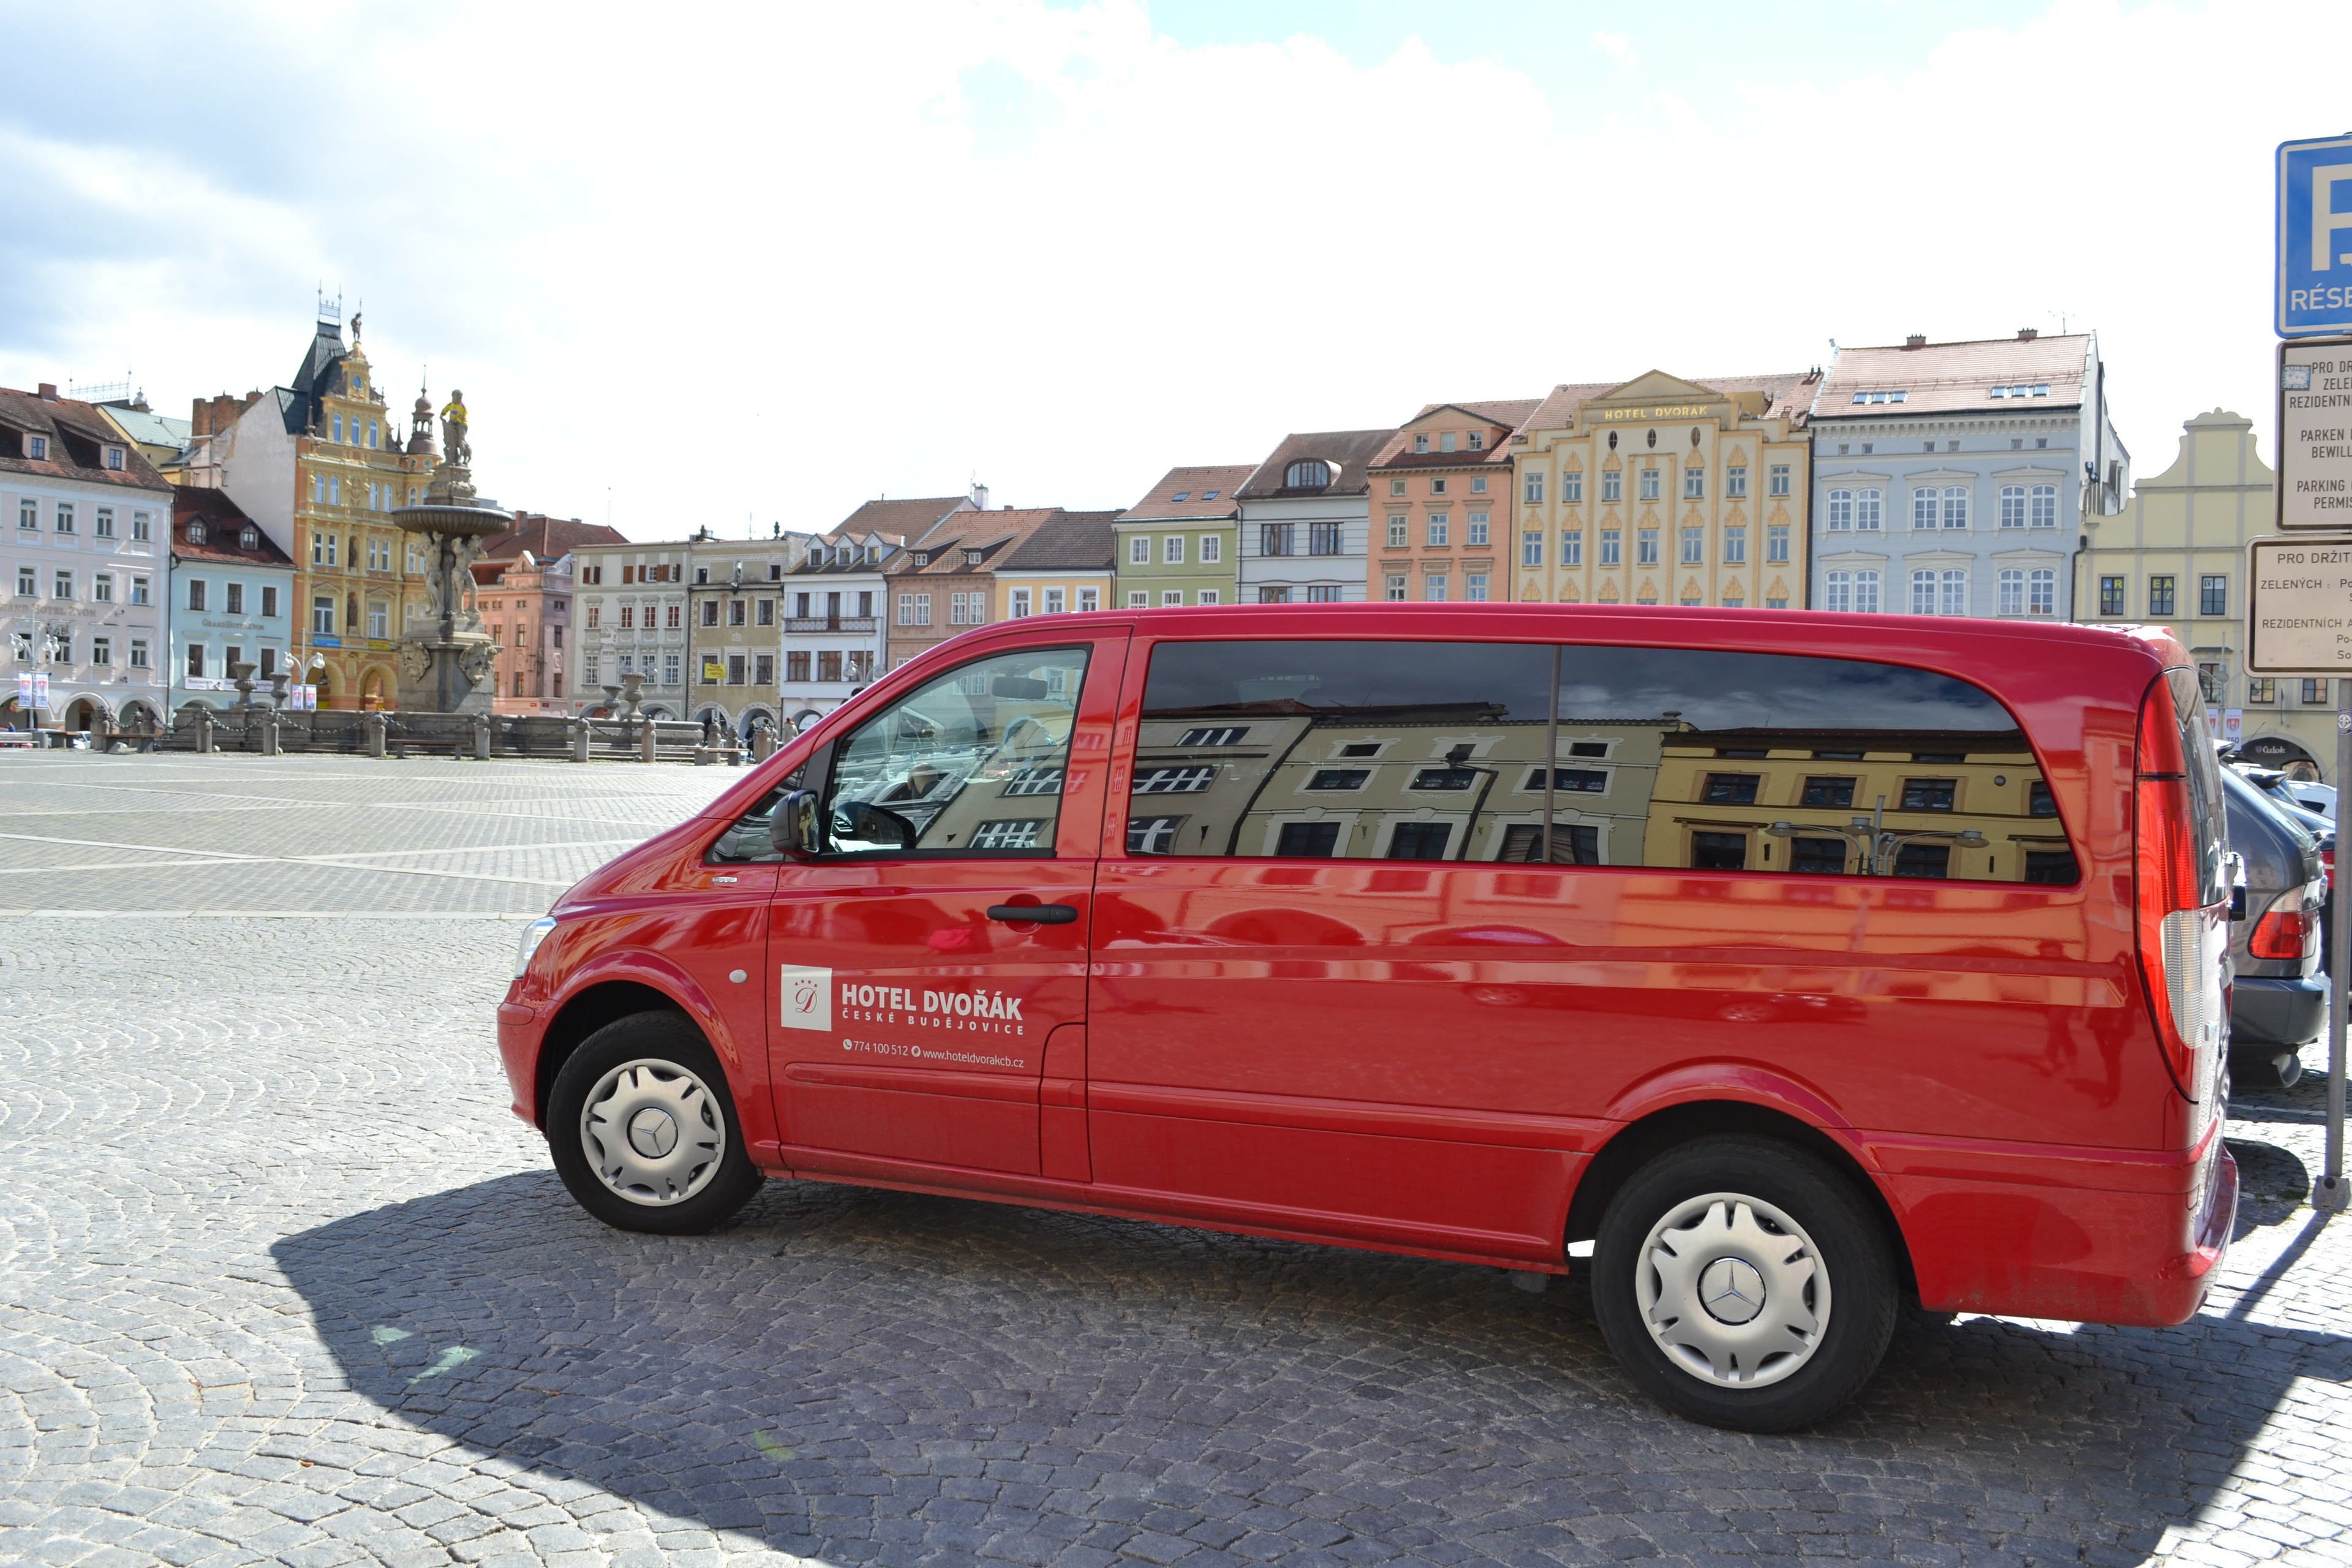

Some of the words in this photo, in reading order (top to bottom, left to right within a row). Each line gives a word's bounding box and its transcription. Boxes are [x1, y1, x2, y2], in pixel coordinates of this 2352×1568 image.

[2312, 361, 2333, 374] PRO
[2323, 377, 2352, 391] ZELE
[2290, 394, 2352, 409] REZIDENTN
[1605, 409, 1646, 420] HOTEL
[2301, 428, 2344, 442] PARKEN
[2297, 480, 2345, 492] PARKING
[2277, 553, 2304, 564] PRO
[2311, 550, 2352, 564] DRŽIT
[2261, 578, 2322, 589] ZELENÝCH
[2262, 617, 2342, 628] REZIDENTNÍCH
[842, 984, 916, 1011] HOTEL
[924, 989, 1022, 1020] DVOŘÁK
[842, 1008, 894, 1023] ČESKÉ
[908, 1016, 1023, 1035] BUDĚJOVICE
[854, 1041, 870, 1052] 774
[873, 1043, 889, 1054] 100
[891, 1045, 908, 1056] 512
[923, 1050, 1024, 1068] www.hoteldvorakcb.cz
